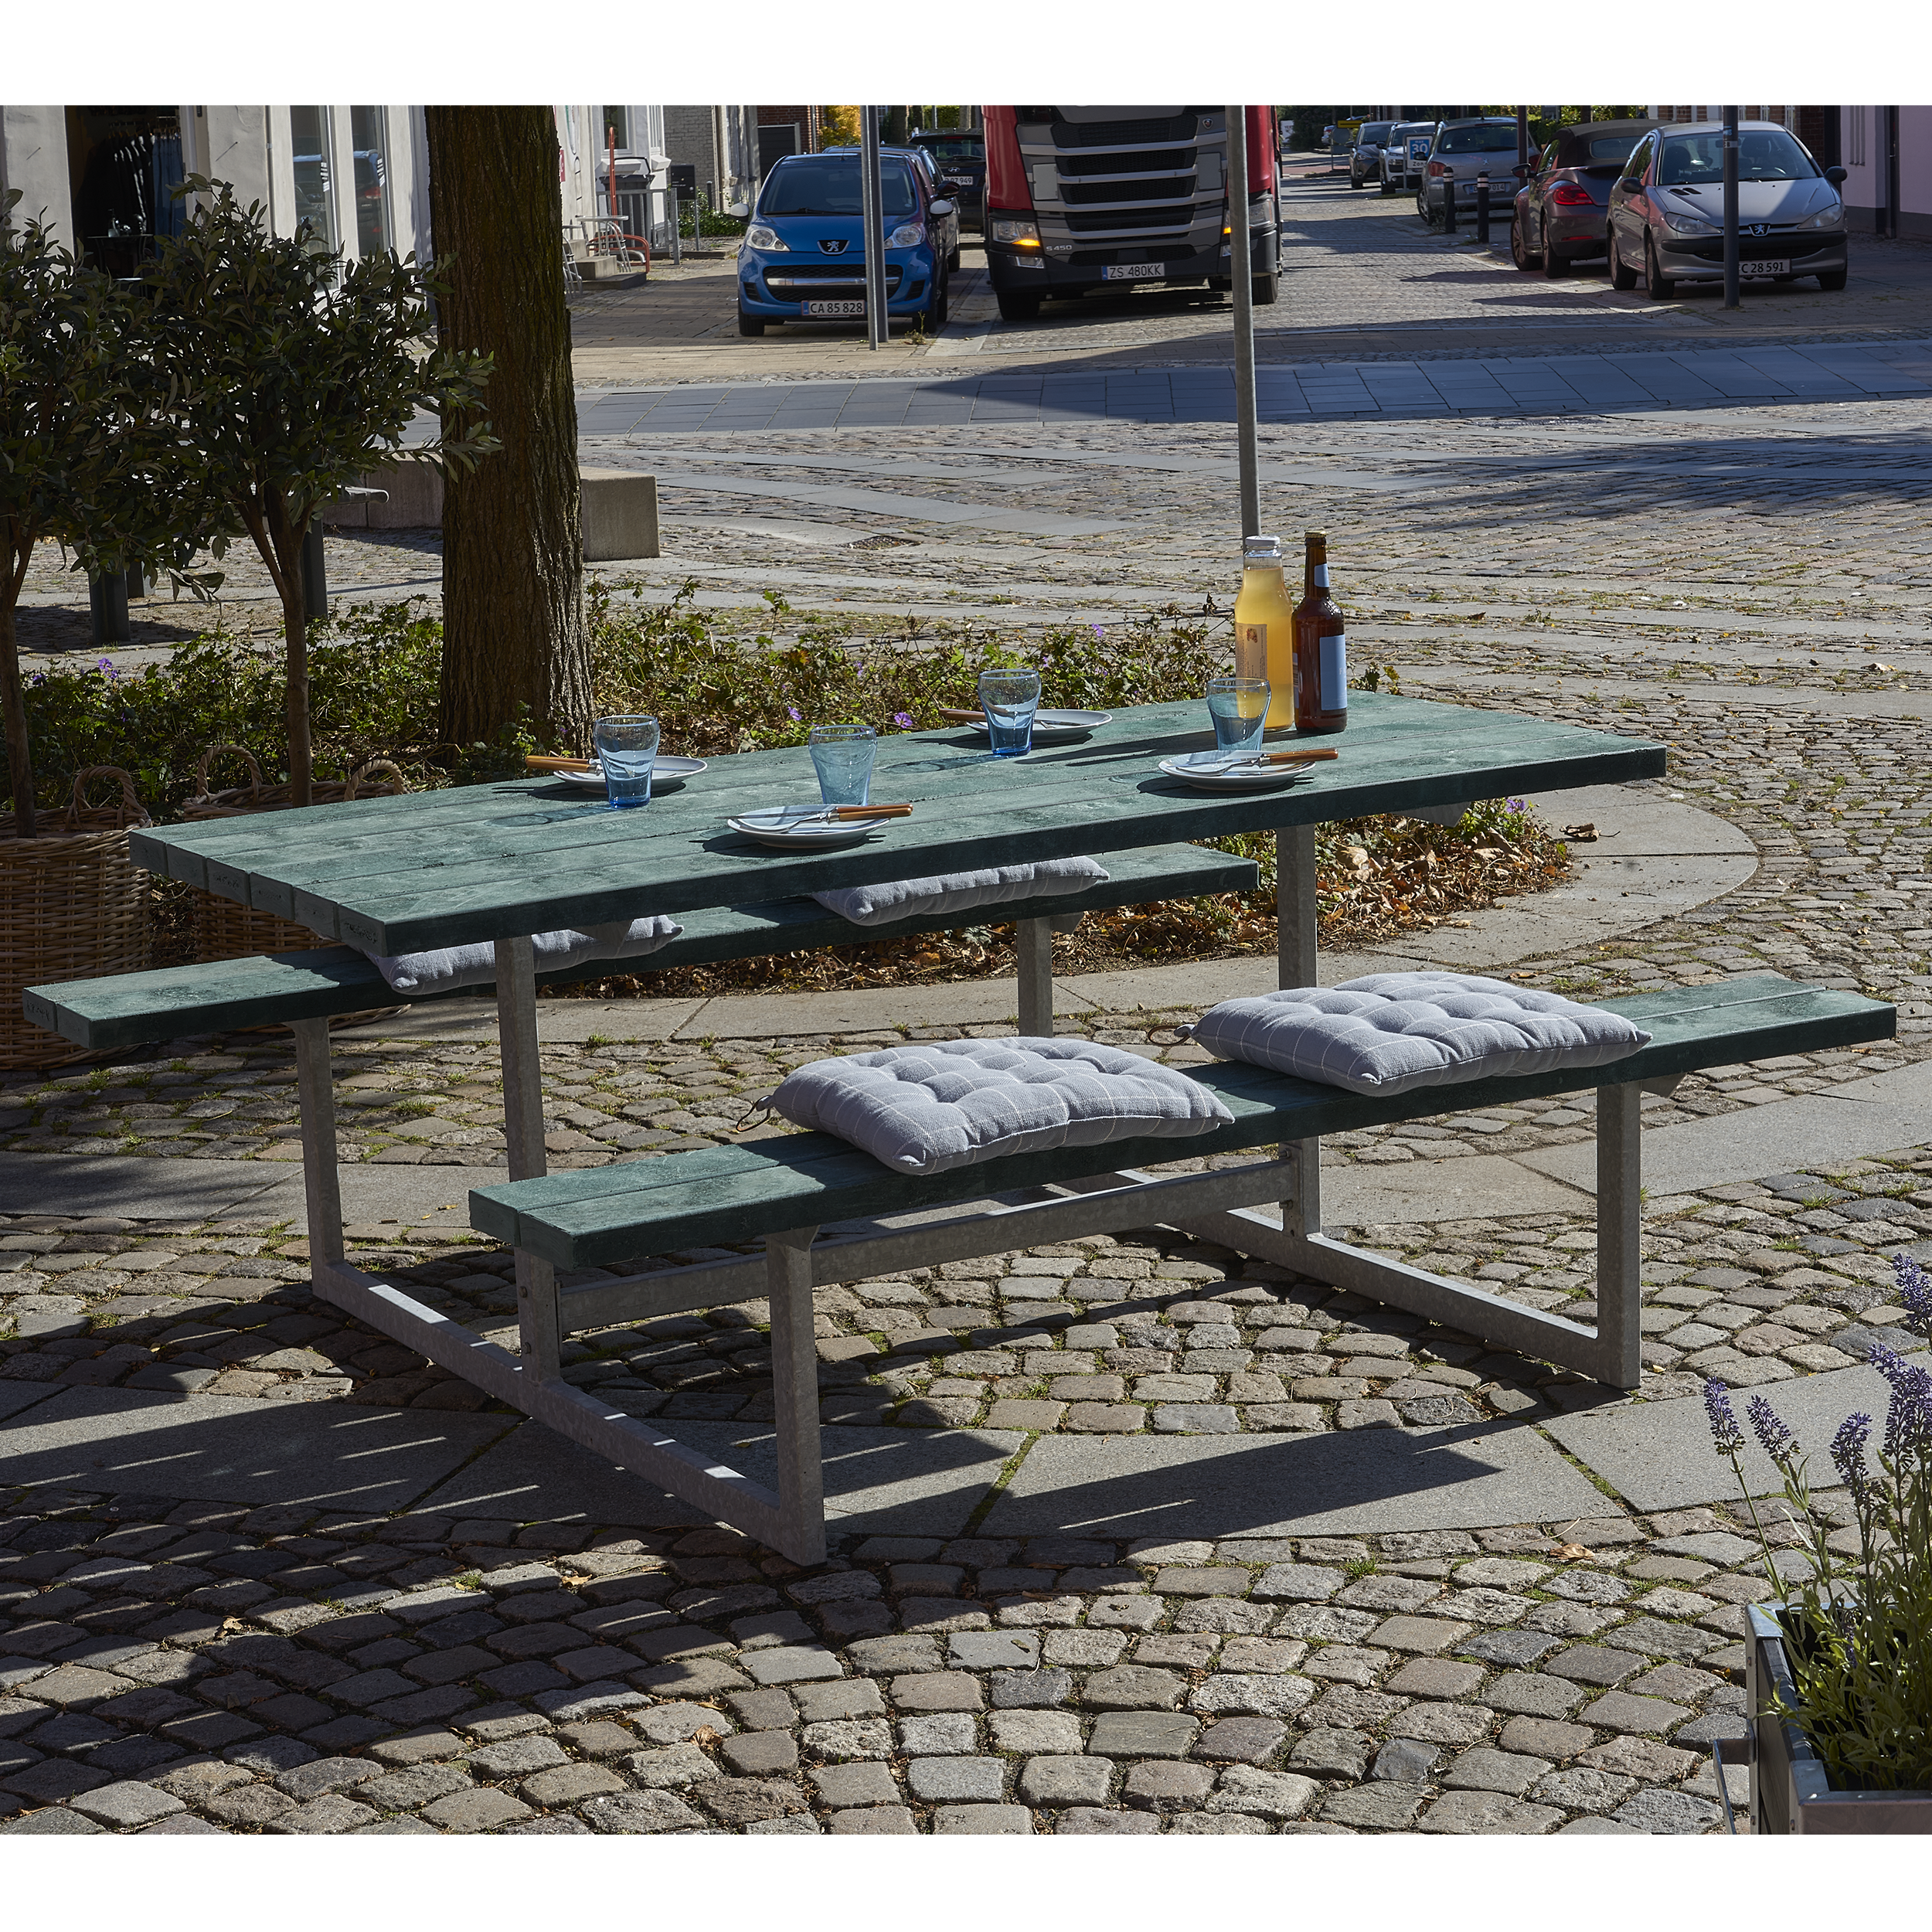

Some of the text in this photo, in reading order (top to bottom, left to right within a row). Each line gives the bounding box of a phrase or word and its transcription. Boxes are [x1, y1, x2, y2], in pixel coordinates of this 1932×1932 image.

[1411, 143, 1429, 155] 30
[1109, 264, 1162, 278] ZS 480KK
[1751, 262, 1764, 274] 28
[1766, 261, 1784, 272] 591
[810, 302, 862, 314] CA 85 828
